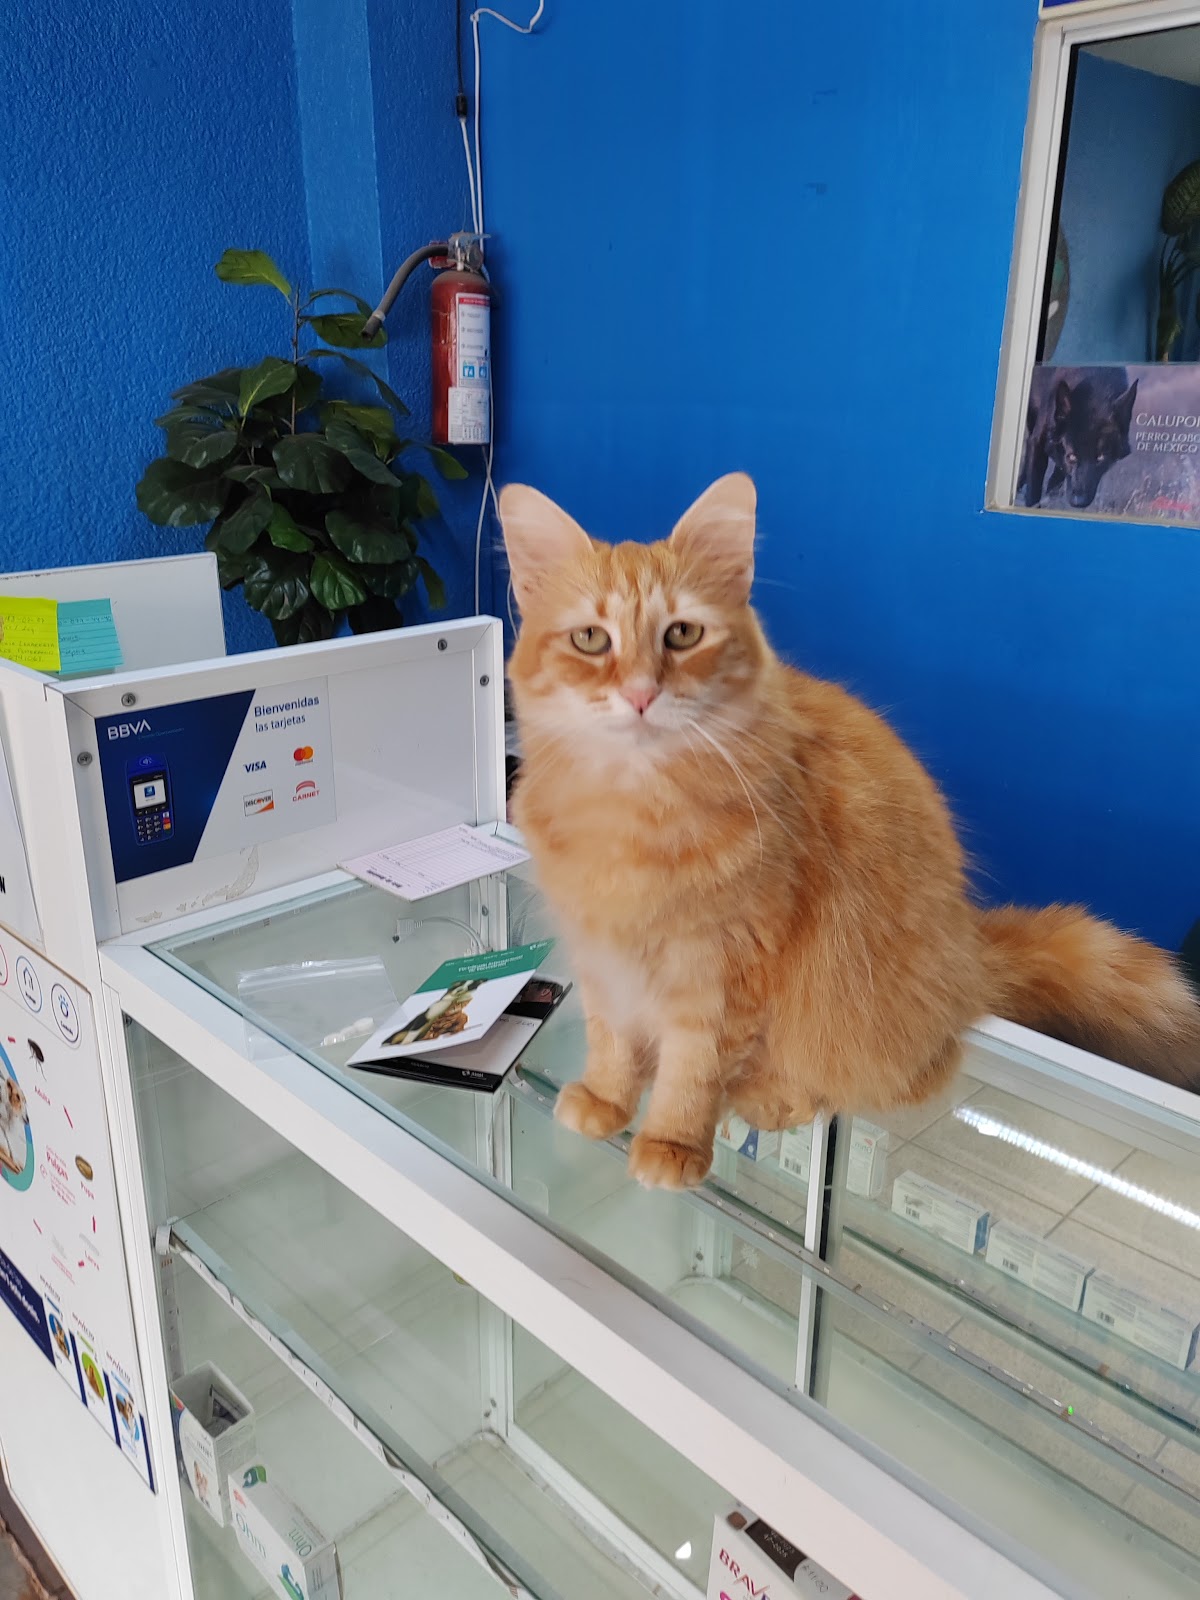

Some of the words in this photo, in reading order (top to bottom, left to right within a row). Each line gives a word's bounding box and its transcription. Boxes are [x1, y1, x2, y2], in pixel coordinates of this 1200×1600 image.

[1135, 431, 1170, 441] PERRO
[1136, 442, 1150, 452] DE
[254, 696, 320, 718] Bienvenidas
[107, 719, 151, 741] BBVA
[255, 722, 270, 733] las
[271, 714, 306, 730] tarjetas
[243, 760, 267, 773] VISA
[235, 1512, 267, 1560] Ohm
[288, 1528, 312, 1557] Ohm
